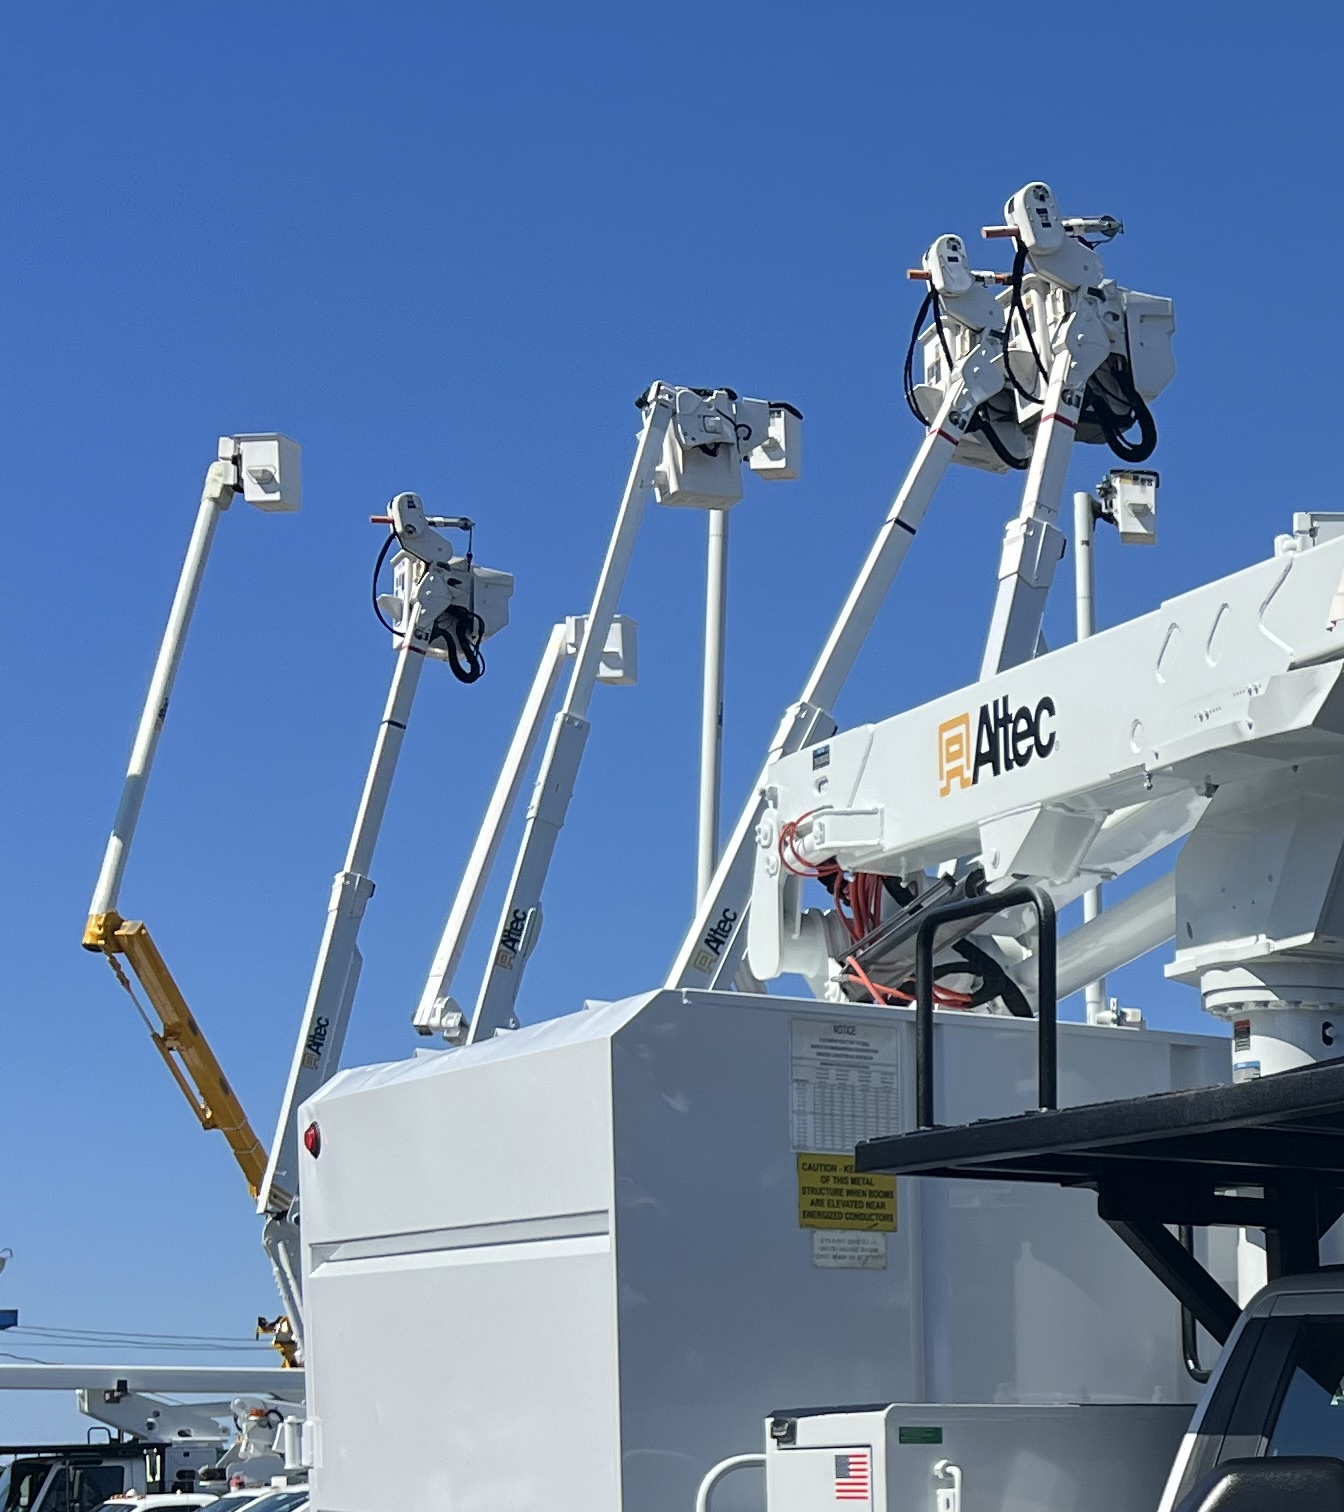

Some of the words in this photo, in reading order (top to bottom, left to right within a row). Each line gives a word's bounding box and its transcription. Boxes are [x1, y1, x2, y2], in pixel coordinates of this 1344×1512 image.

[972, 694, 1056, 786] Altec
[501, 909, 527, 955] Altec
[703, 908, 738, 956] Altec
[306, 1016, 330, 1056] Altec
[801, 1162, 838, 1173] CAUTION
[820, 1176, 830, 1184] OF
[832, 1176, 849, 1185] THIS
[851, 1177, 875, 1187] METAL
[801, 1186, 844, 1197] STRUCTURE
[846, 1189, 867, 1198] WHEN
[868, 1190, 894, 1199] BOOMS
[810, 1198, 825, 1207] ARE
[827, 1199, 865, 1209] ELEVATED
[865, 1201, 886, 1210] NEAR
[802, 1210, 843, 1220] ENERGIZED
[844, 1212, 894, 1222] CONDUCTORS
